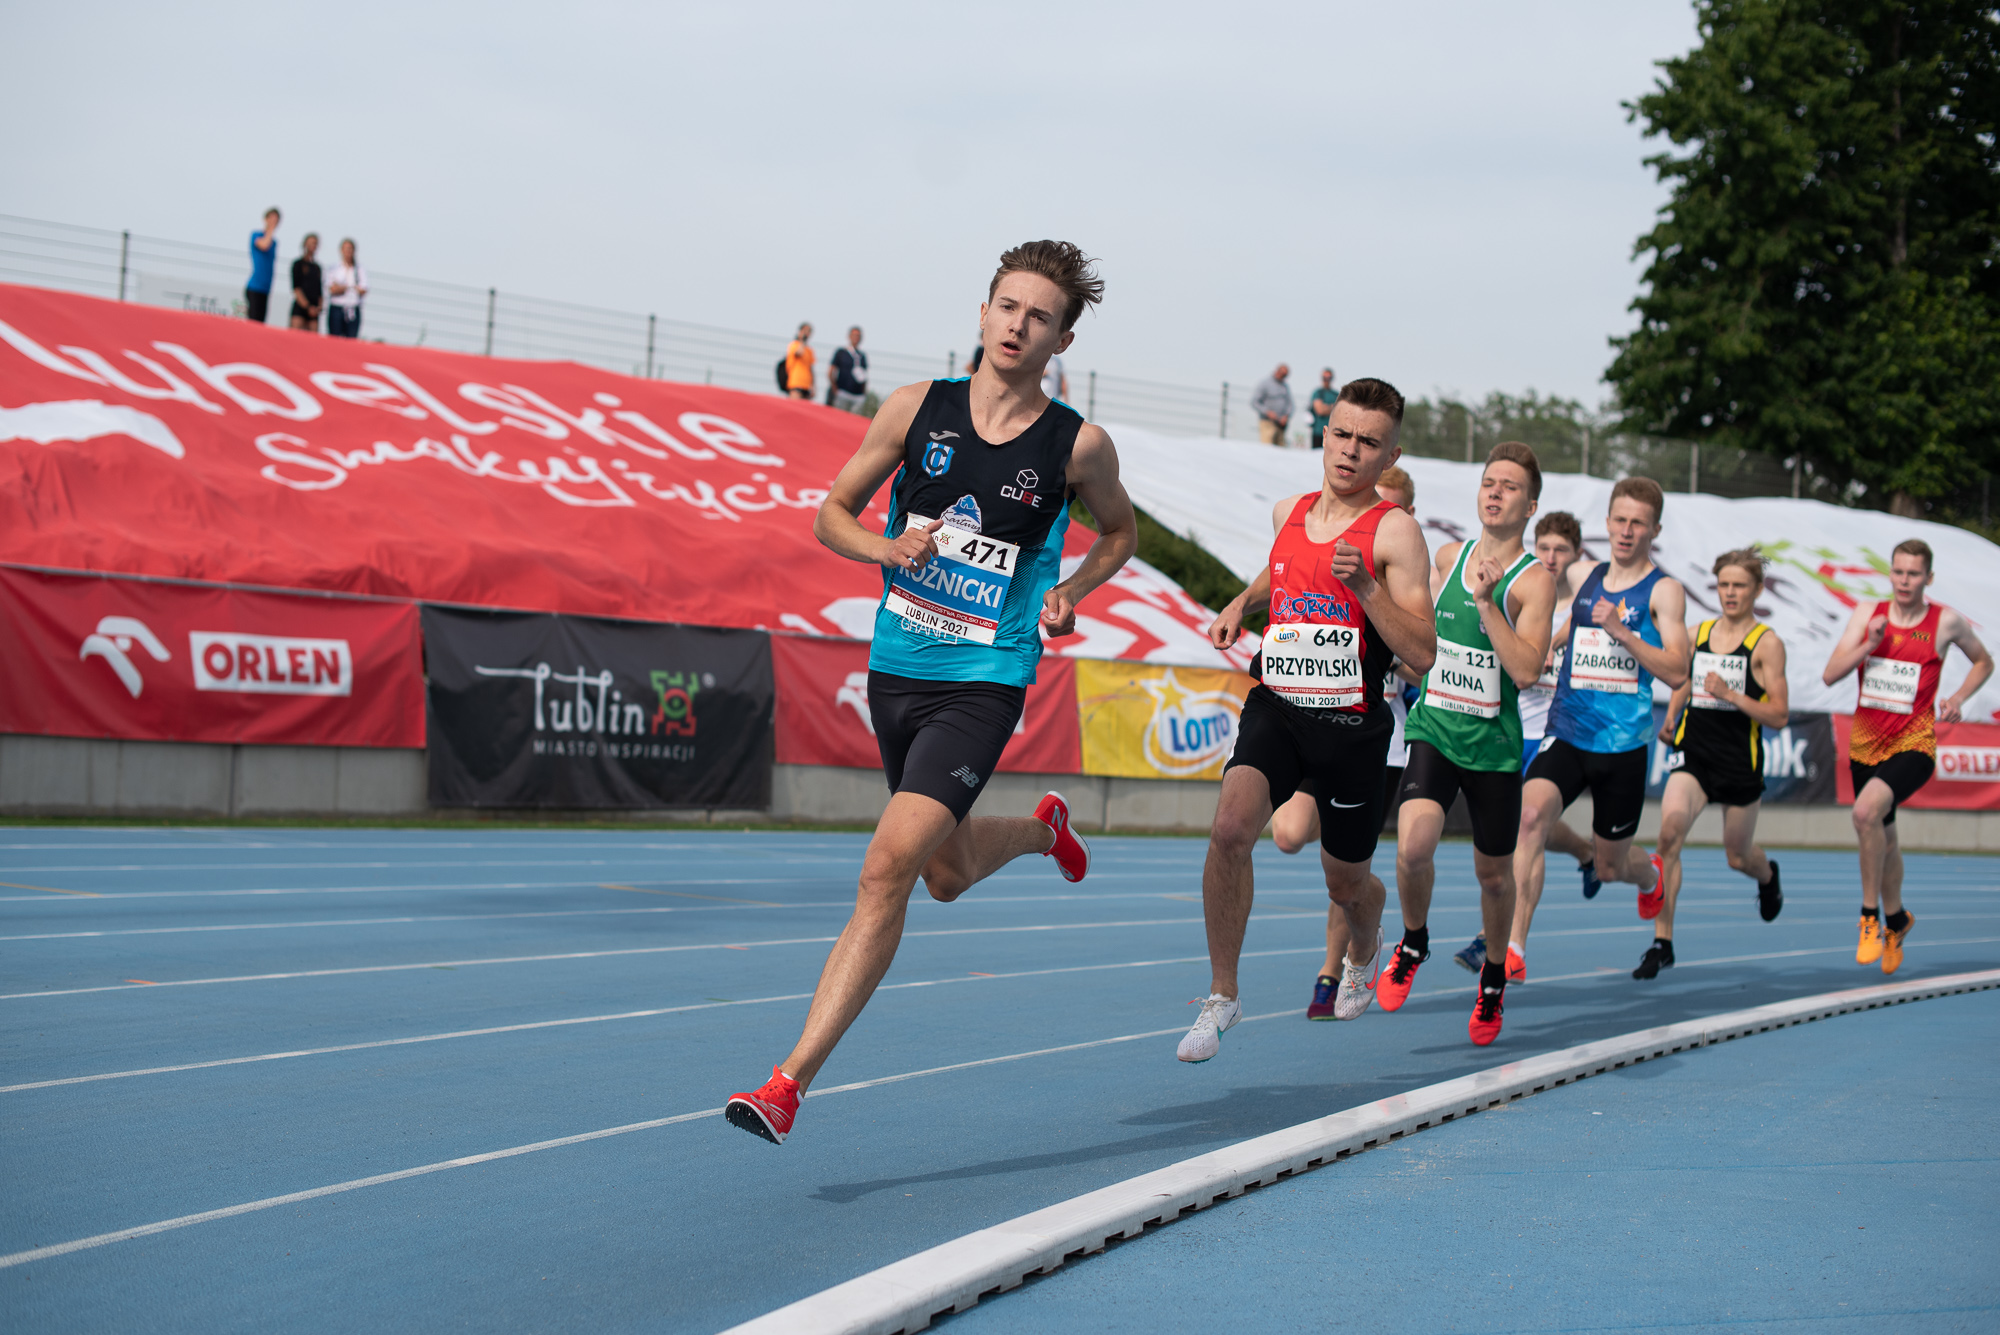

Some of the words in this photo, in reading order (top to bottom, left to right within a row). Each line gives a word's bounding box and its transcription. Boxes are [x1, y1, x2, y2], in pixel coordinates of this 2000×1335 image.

[1000, 484, 1043, 509] CUBE
[960, 538, 1009, 571] 471
[905, 605, 939, 627] LUBLIN
[940, 619, 969, 637] 2021
[914, 597, 956, 617] MISTRZOSTWA
[956, 613, 979, 625] POLSKI
[979, 620, 993, 628] U20
[1291, 597, 1351, 623] ORKAN
[1278, 631, 1296, 641] LOTTO
[1313, 628, 1354, 647] 649
[202, 641, 341, 686] ORLEN
[1266, 656, 1358, 678] PRZYBYLSKI
[1465, 651, 1496, 669] 121
[1574, 653, 1637, 671] ZABAGŁO
[1720, 659, 1743, 671] 444
[1441, 669, 1485, 693] KUNA
[1582, 682, 1604, 690] LUBLIN
[1606, 683, 1622, 692] 2021
[474, 661, 647, 736] Lublin
[1318, 697, 1341, 706] 2021
[1441, 699, 1465, 711] LUBLIN
[1466, 705, 1484, 715] 2021
[1318, 709, 1364, 726] PRO
[1169, 711, 1231, 752] LOTTO
[533, 739, 598, 757] MIASTO
[603, 742, 696, 762] INSPIRACJI
[1941, 752, 2000, 775] ORLE
